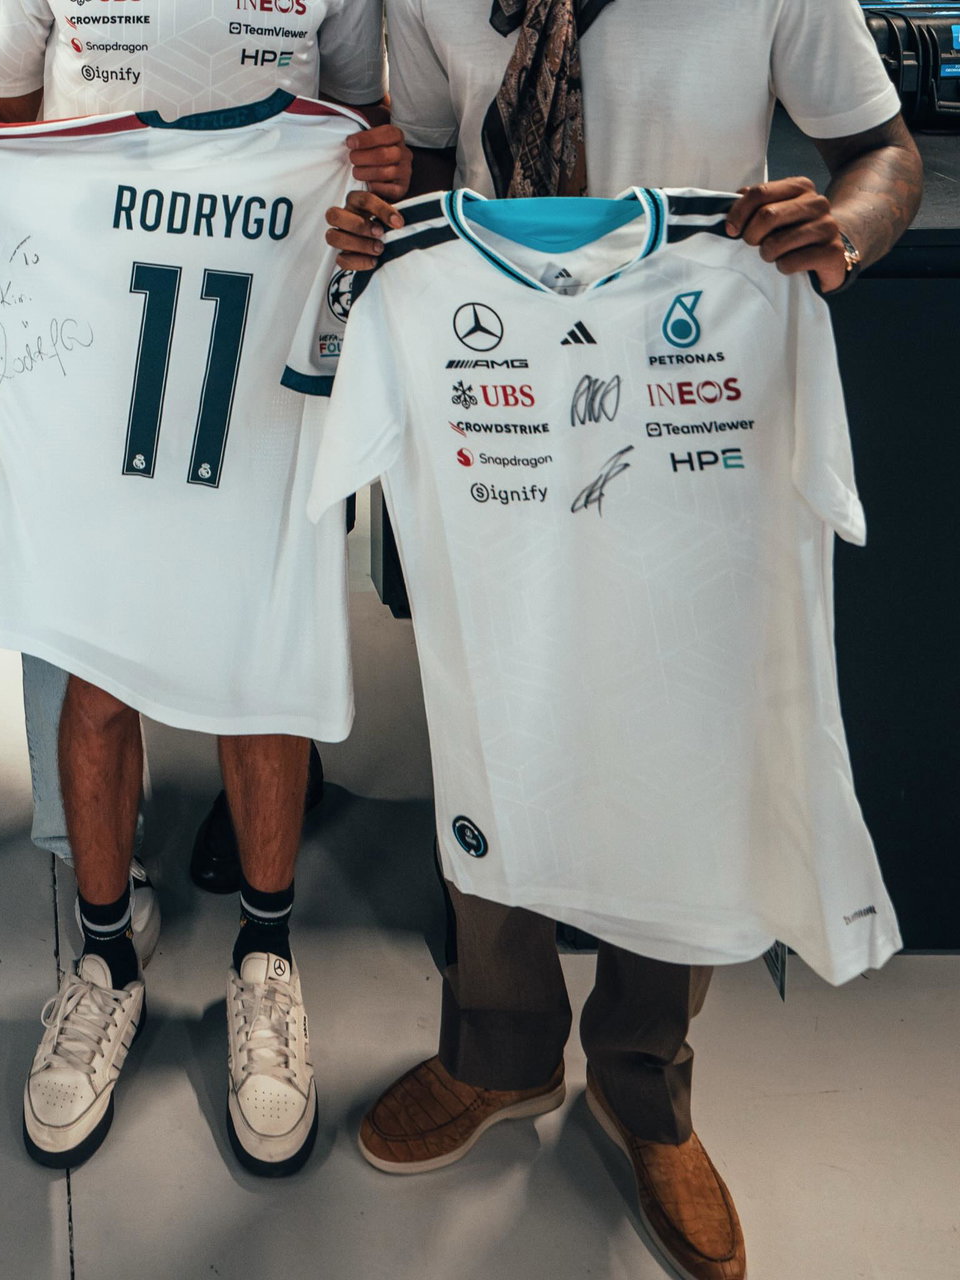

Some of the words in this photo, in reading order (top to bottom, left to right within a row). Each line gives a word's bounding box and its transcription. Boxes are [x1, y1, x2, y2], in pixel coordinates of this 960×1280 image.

[70, 15, 151, 25] CROWDSTRIKE
[243, 24, 308, 39] TeamViewer
[86, 41, 149, 53] Snapdragon
[240, 48, 294, 68] HPE
[112, 184, 294, 241] RODRYGO
[472, 359, 529, 370] AMG
[648, 351, 725, 367] PETRONAS
[122, 261, 254, 489] 11
[480, 384, 535, 408] UBS
[646, 377, 742, 408] INEOS
[456, 421, 550, 435] CROWDSTRIKE
[665, 419, 756, 437] TeamViewer
[479, 452, 553, 469] Snapdragon
[670, 448, 745, 473] HPE
